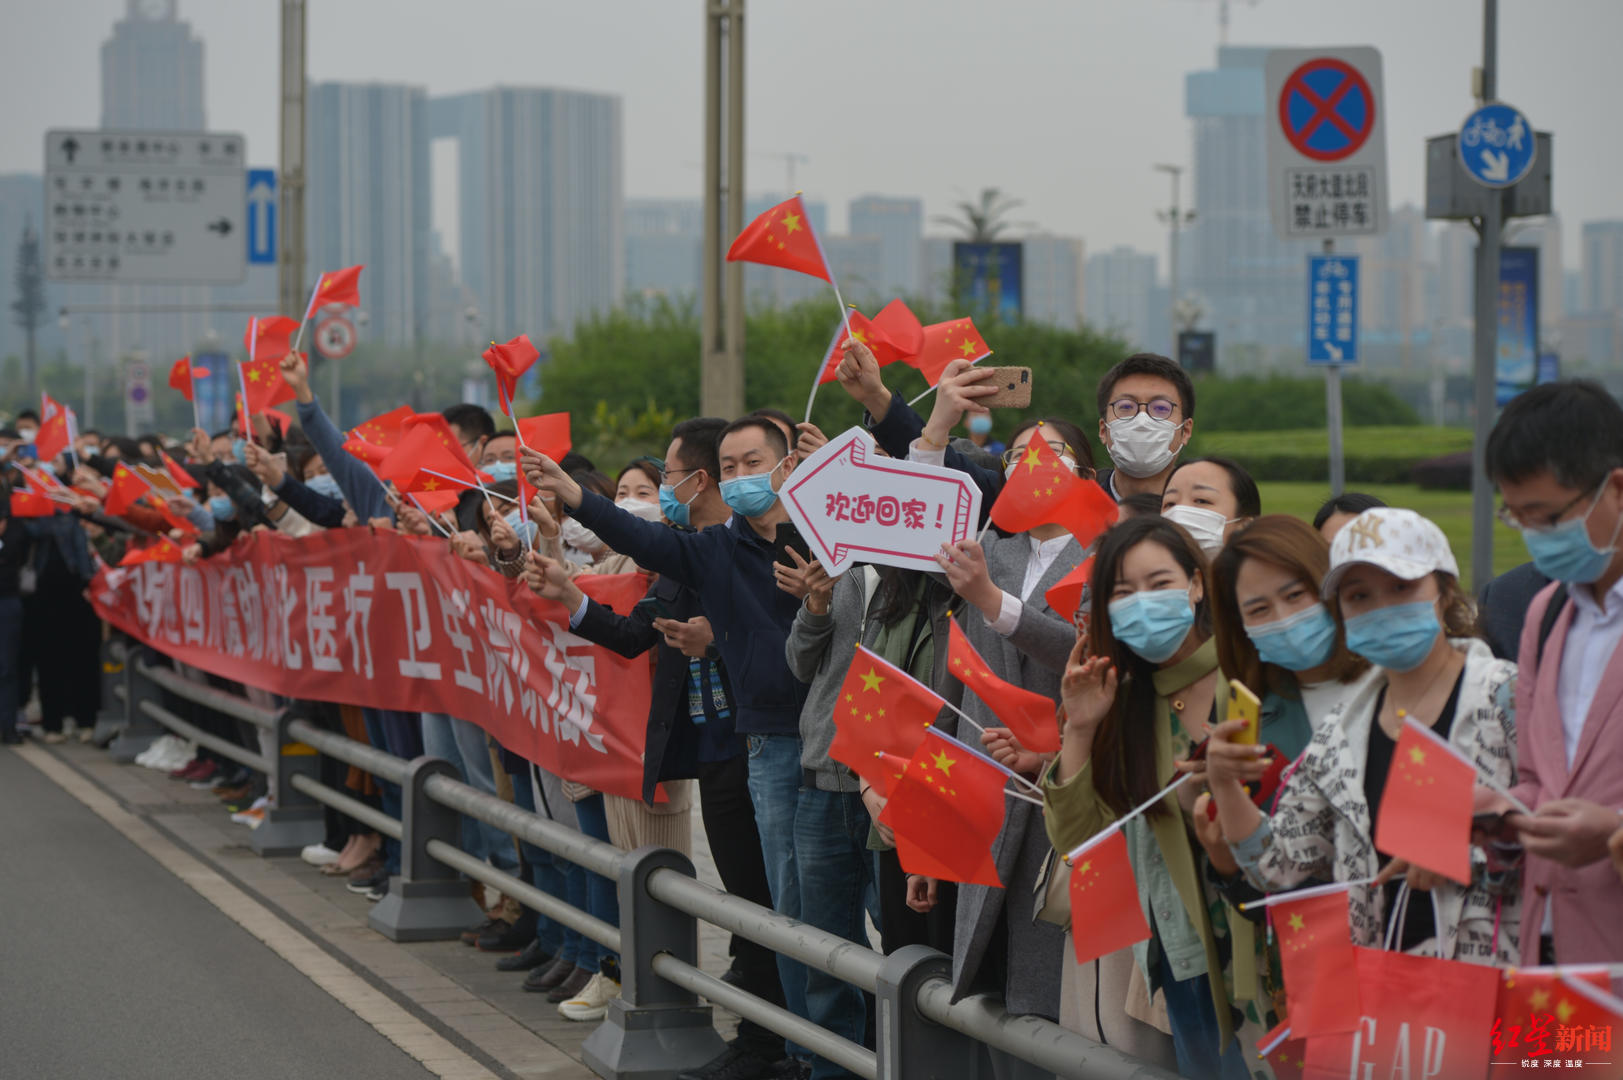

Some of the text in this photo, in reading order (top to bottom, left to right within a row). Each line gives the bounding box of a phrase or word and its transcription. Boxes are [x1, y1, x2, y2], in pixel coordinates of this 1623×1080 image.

[1293, 173, 1369, 198] 天府大道北段
[1294, 202, 1369, 229] 禁止停车
[825, 492, 945, 530] 欢迎回家！
[1350, 1016, 1447, 1080] GAP
